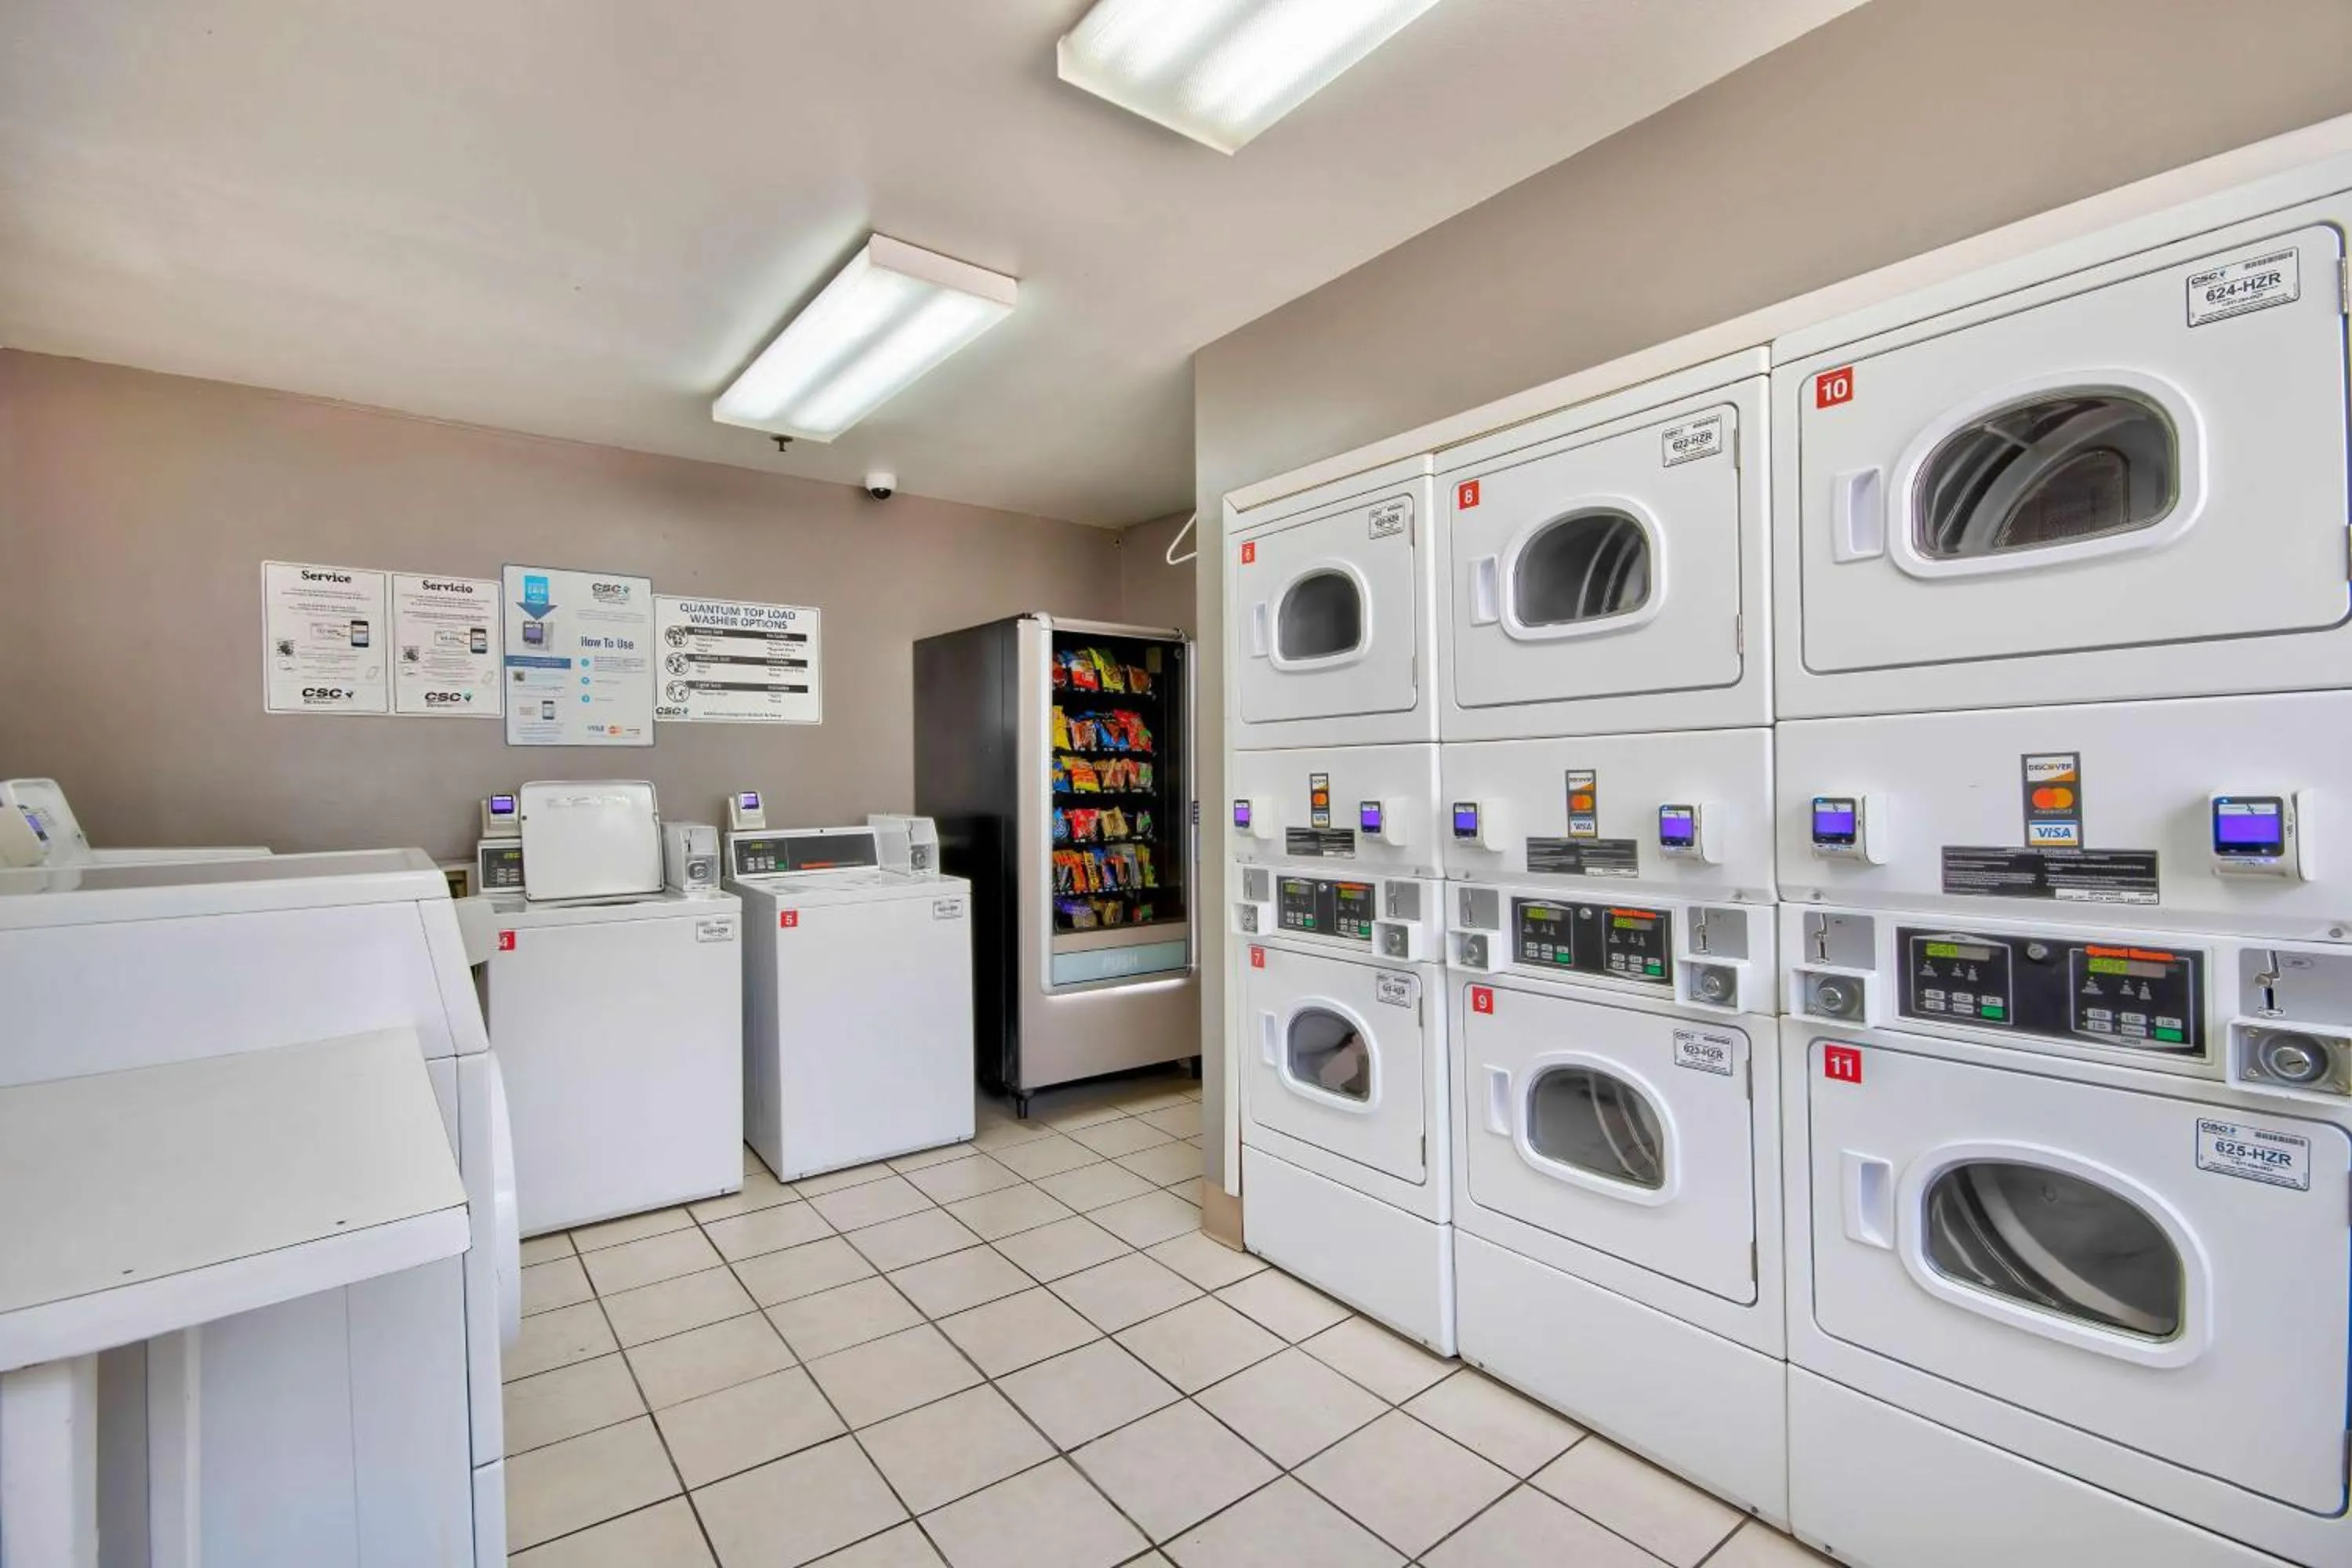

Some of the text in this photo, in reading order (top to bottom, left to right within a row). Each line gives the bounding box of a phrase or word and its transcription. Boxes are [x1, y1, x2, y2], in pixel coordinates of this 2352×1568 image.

[2206, 273, 2281, 302] 624-HZR
[1821, 378, 1848, 401] 10
[1465, 489, 1473, 503] 8
[301, 570, 352, 583] Service
[422, 580, 473, 593] Servicio
[592, 583, 621, 593] CSC
[680, 602, 796, 620] QUANTUM TOP LOAD
[690, 614, 787, 630] WASHER OPTIONS
[581, 636, 634, 649] How To Use
[302, 688, 343, 699] CSC
[424, 691, 462, 702] CSC
[655, 706, 681, 715] CSC
[2037, 827, 2071, 838] VISA
[785, 915, 793, 926] 5
[1478, 994, 1486, 1009] 9
[1831, 1056, 1853, 1077] 11
[2215, 1141, 2292, 1167] 625-HZR
